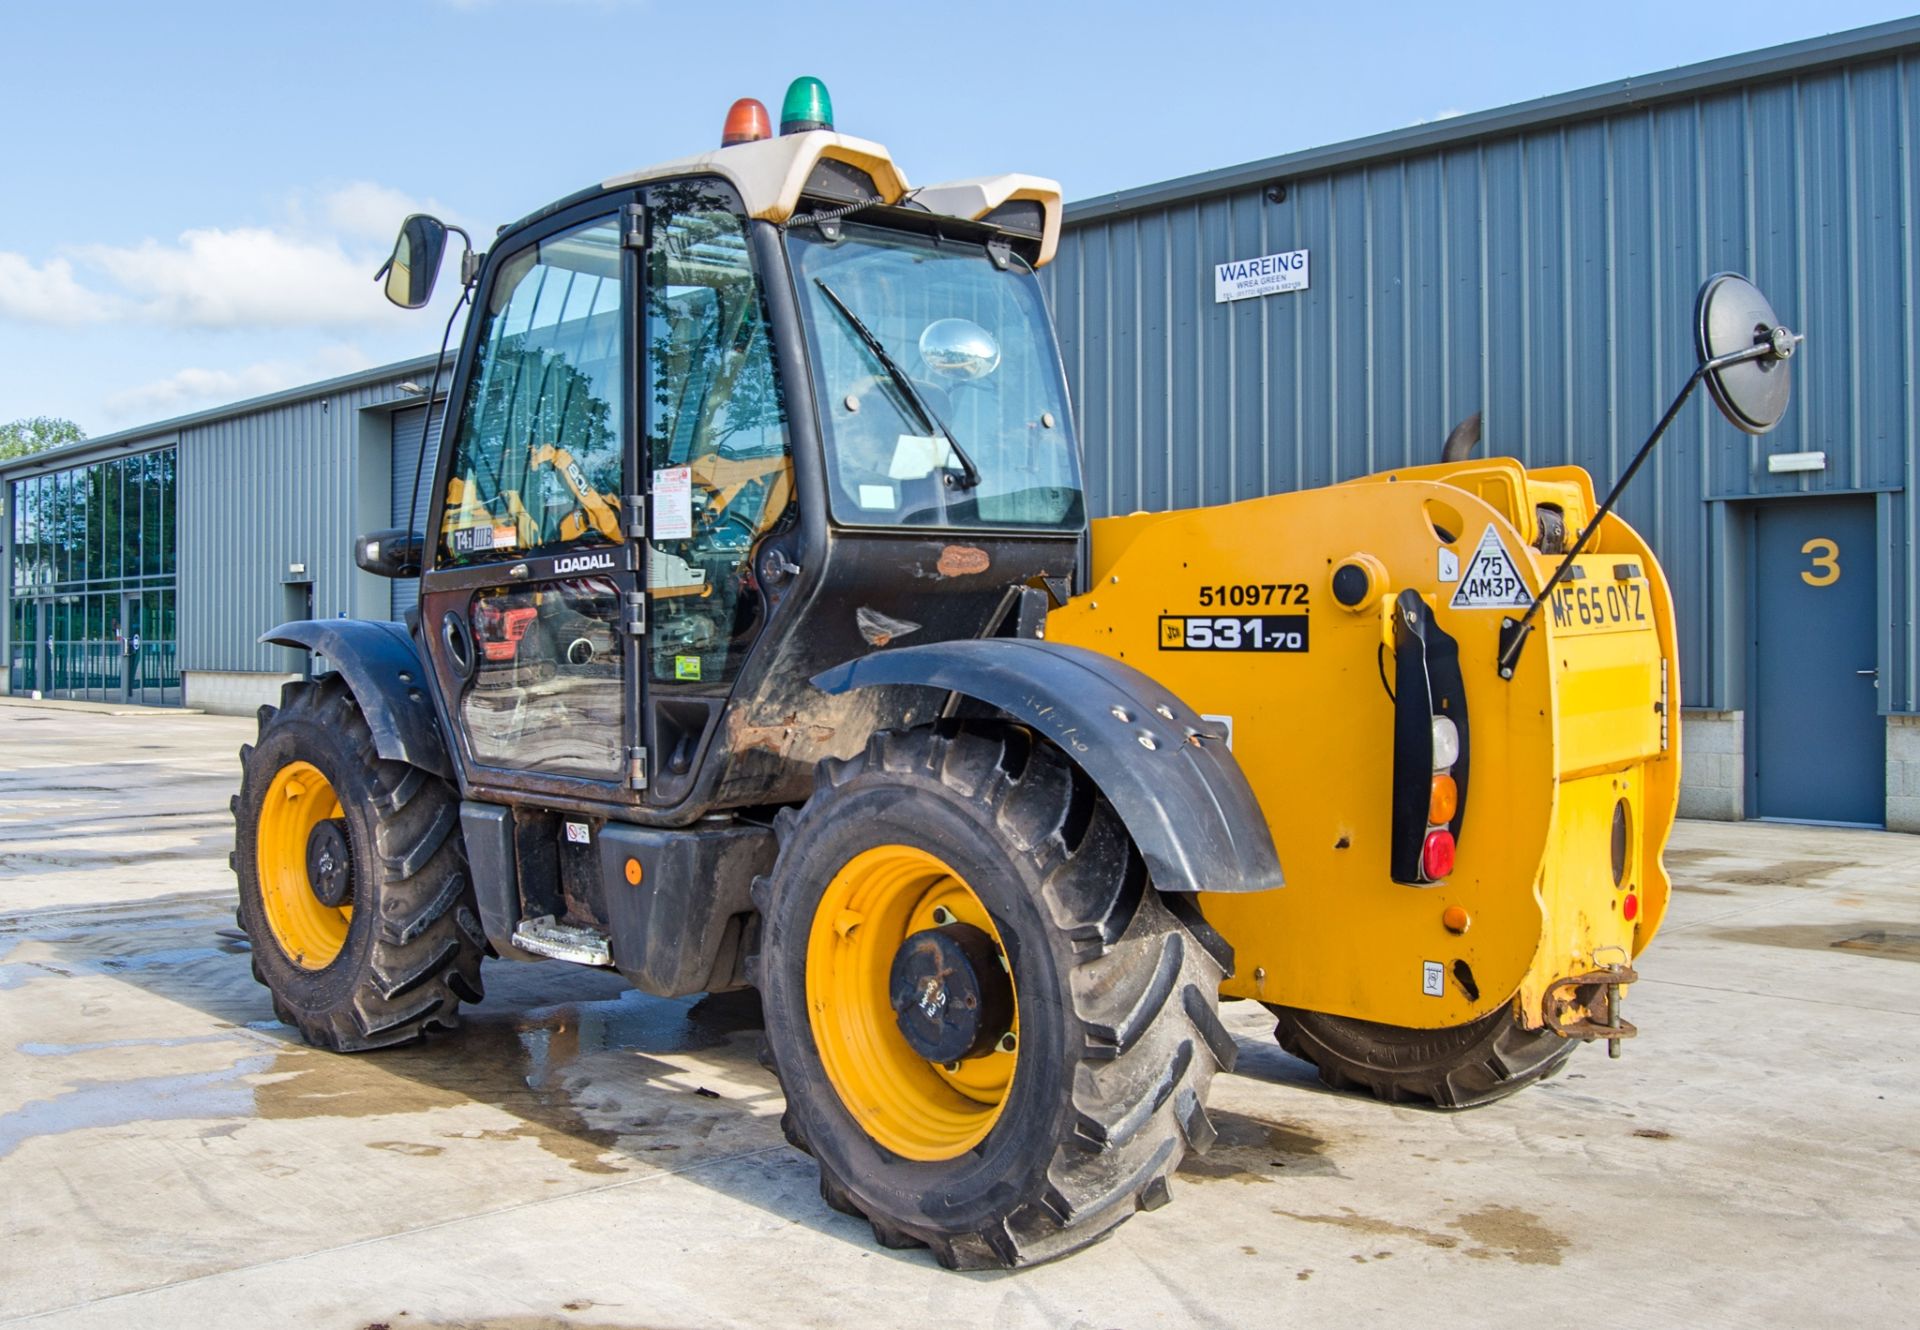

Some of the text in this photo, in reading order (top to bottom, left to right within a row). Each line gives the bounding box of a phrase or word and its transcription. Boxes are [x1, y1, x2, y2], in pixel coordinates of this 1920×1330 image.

[1220, 253, 1303, 282] WAREING
[1236, 274, 1287, 289] WREA GREEN
[554, 553, 615, 574] LOADALL
[1480, 556, 1502, 577] 75
[1801, 537, 1841, 587] 3
[1200, 584, 1309, 607] 5109772
[1469, 577, 1515, 598] AM3P
[1550, 586, 1604, 628] MF65
[1186, 618, 1302, 649] 531-70
